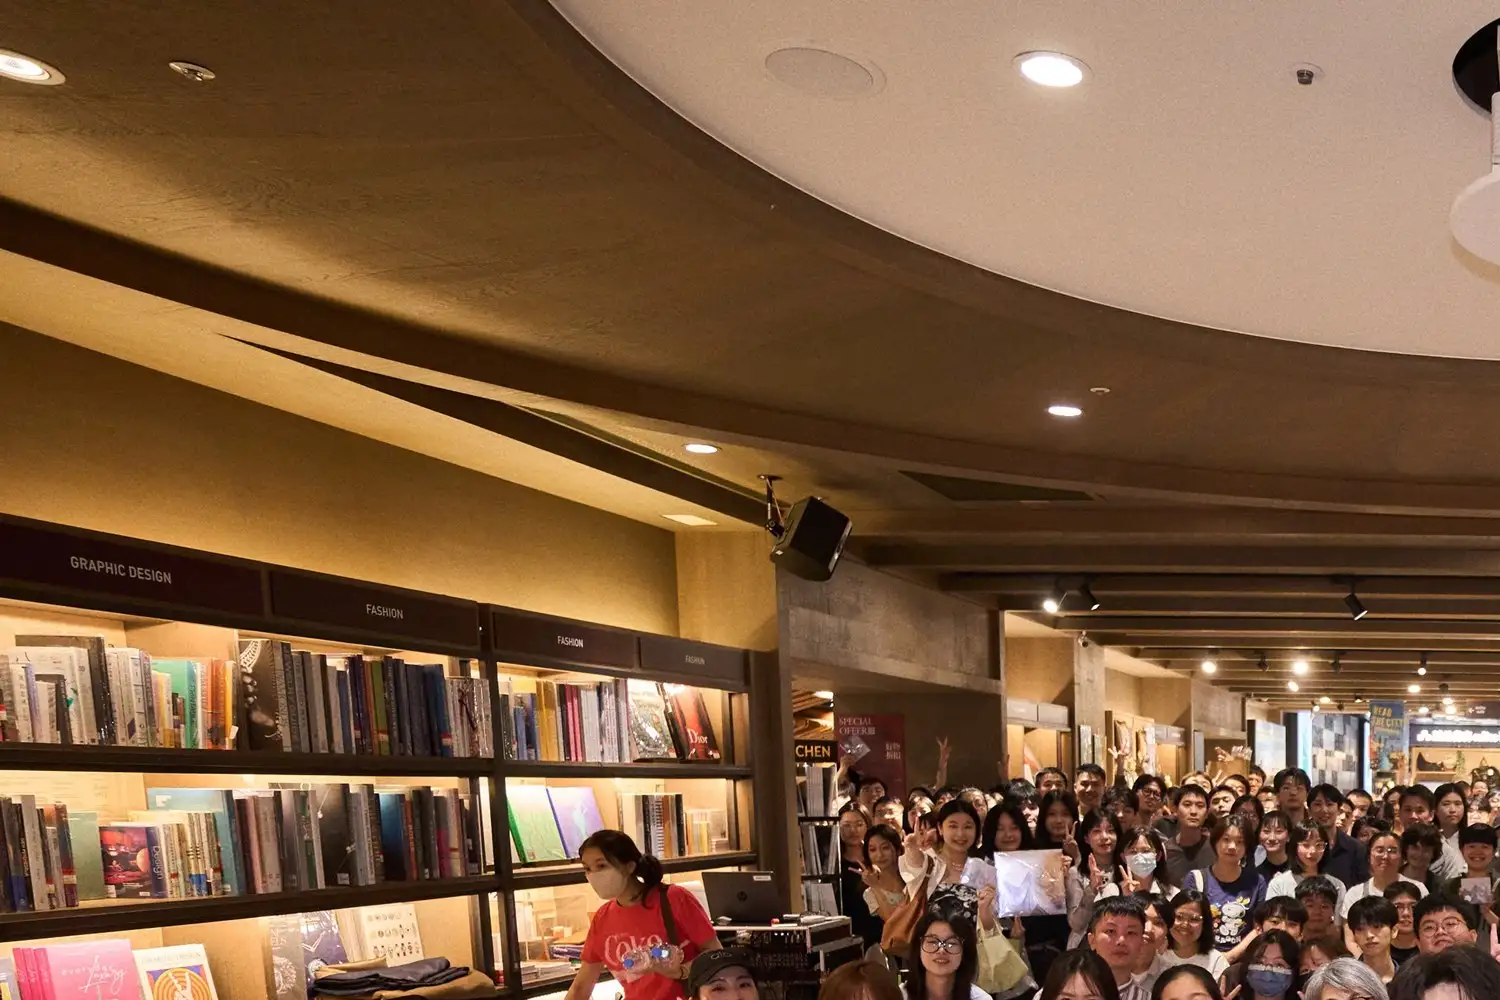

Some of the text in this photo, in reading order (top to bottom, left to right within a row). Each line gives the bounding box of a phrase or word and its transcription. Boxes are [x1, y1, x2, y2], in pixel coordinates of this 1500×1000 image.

[70, 556, 172, 584] GRAPHIC DESIGN
[366, 604, 404, 620] FASHION
[557, 636, 584, 648] FASHION
[685, 654, 705, 665] FASHION
[839, 717, 873, 726] SPECIAL
[687, 728, 709, 745] Dior
[152, 845, 164, 880] Design
